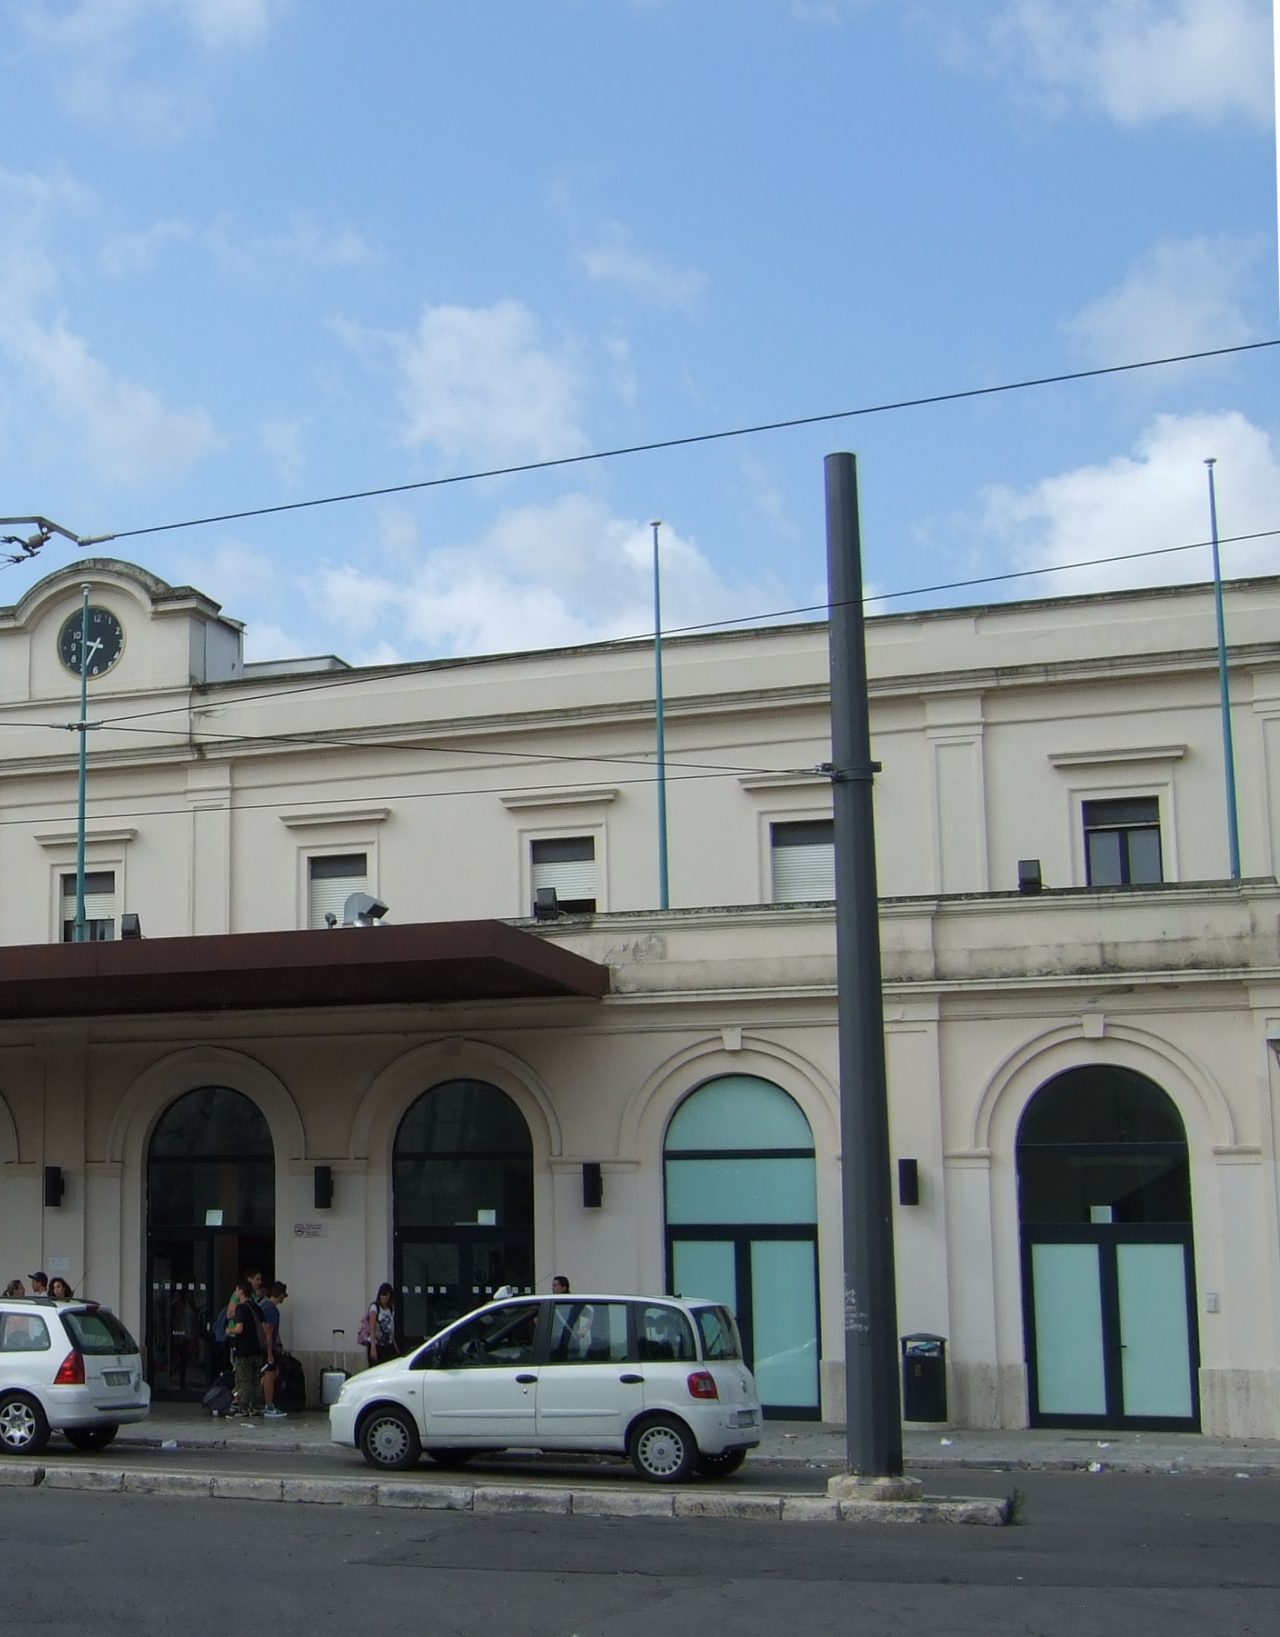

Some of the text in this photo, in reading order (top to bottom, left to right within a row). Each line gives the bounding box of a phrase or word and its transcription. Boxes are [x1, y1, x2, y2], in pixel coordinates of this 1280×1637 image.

[94, 614, 101, 623] 12
[73, 631, 81, 640] 10
[70, 643, 76, 651] 9
[93, 666, 99, 675] 6
